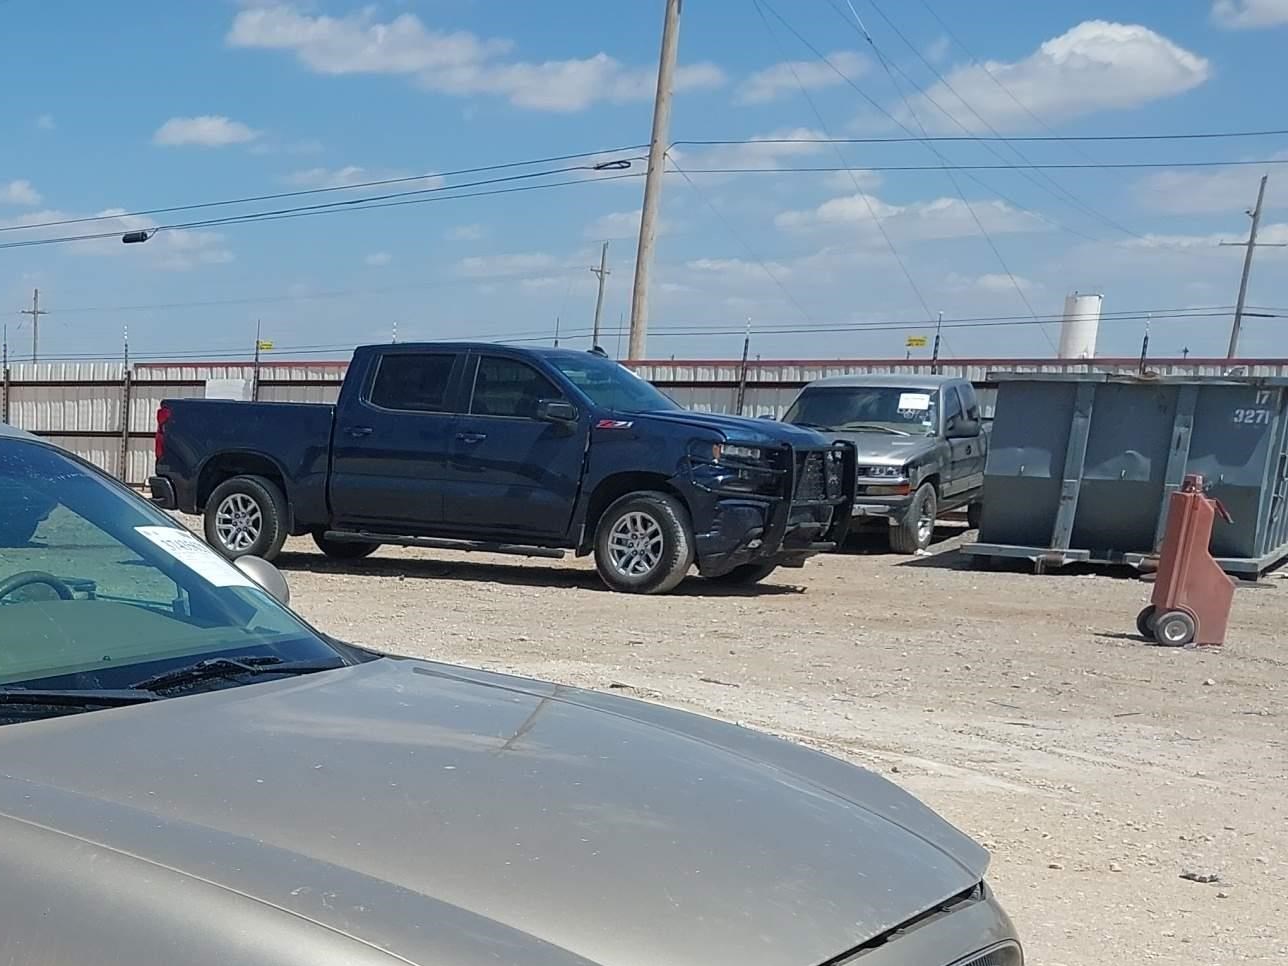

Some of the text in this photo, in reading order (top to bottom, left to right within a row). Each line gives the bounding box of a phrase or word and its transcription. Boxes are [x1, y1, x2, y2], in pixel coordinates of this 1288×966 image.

[1256, 390, 1271, 404] 17
[1233, 408, 1270, 424] 3271
[596, 420, 633, 429] Z71
